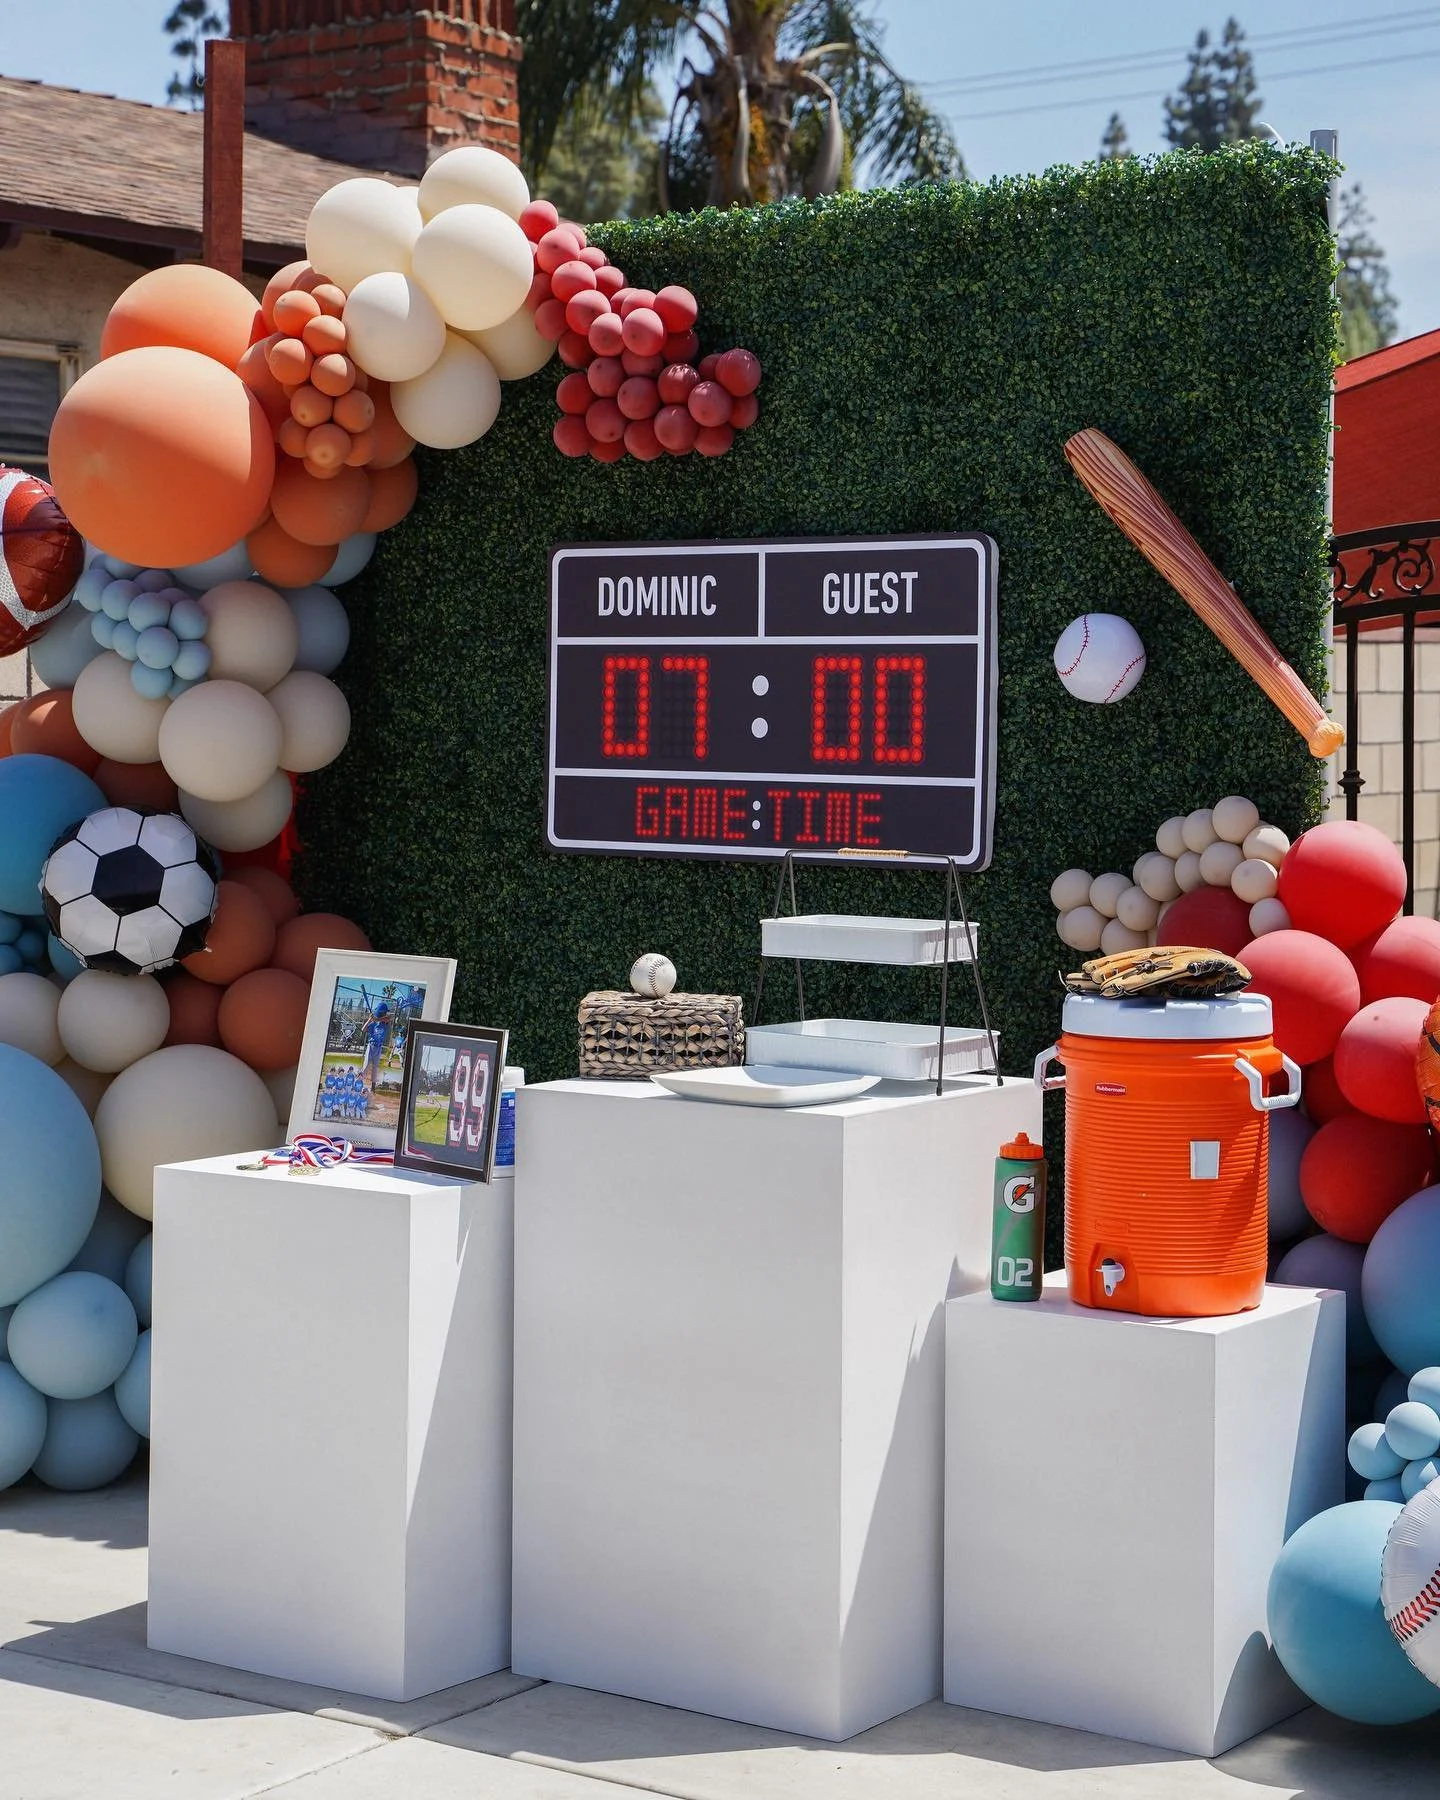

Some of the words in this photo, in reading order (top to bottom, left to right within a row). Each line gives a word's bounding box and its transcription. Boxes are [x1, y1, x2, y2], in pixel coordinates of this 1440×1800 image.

[598, 575, 717, 616] DOMINIC
[822, 571, 919, 614] GUEST
[448, 1049, 489, 1152] 99
[1003, 1175, 1035, 1214] G
[997, 1256, 1034, 1287] 02
